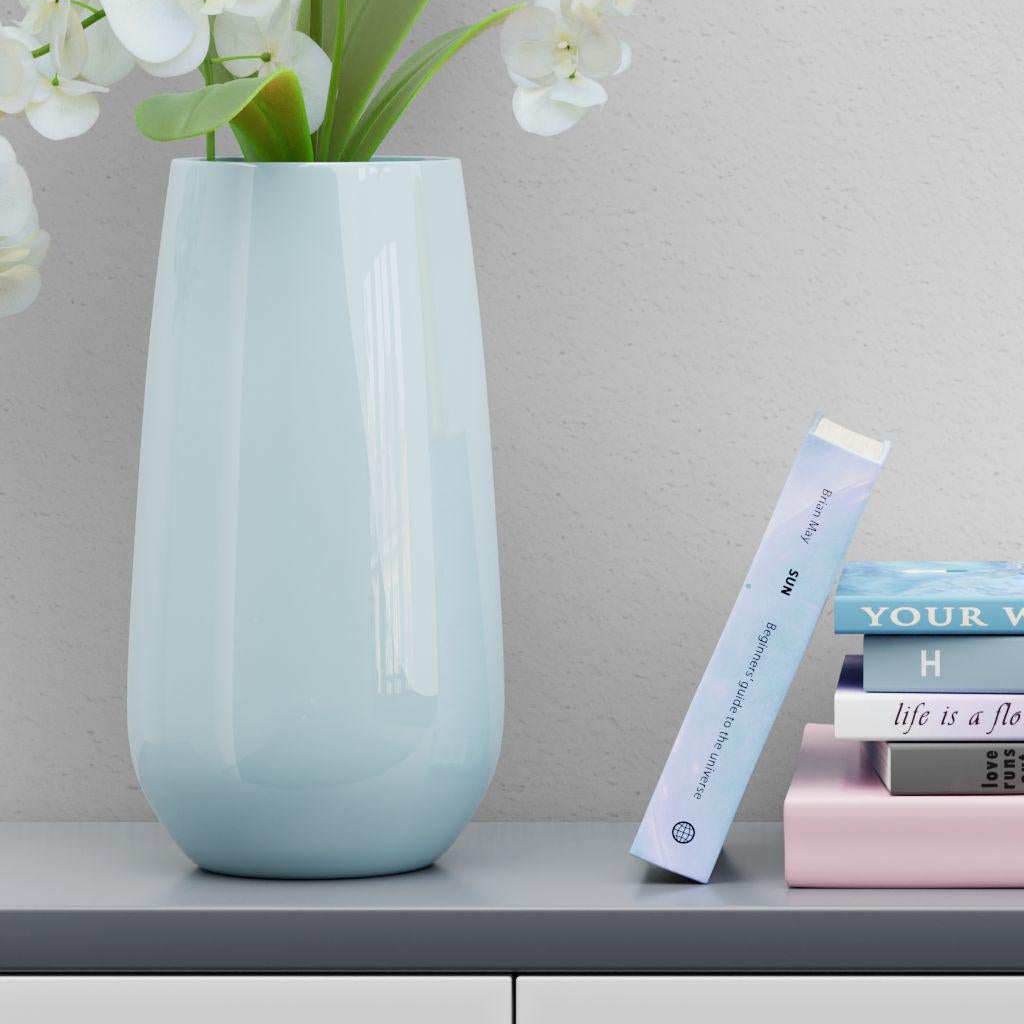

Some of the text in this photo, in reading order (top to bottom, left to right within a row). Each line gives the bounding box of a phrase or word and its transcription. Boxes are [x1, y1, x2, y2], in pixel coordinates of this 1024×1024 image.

[800, 488, 833, 545] Brian May
[780, 568, 799, 596] SUN
[860, 606, 989, 627] YOUR
[729, 680, 749, 714] guide
[723, 715, 735, 728] to
[894, 702, 931, 735] life
[940, 706, 959, 726] is
[968, 710, 984, 726] a
[713, 731, 729, 750] the
[693, 752, 719, 801] universe
[981, 750, 999, 788] love
[1003, 749, 1016, 790] runs
